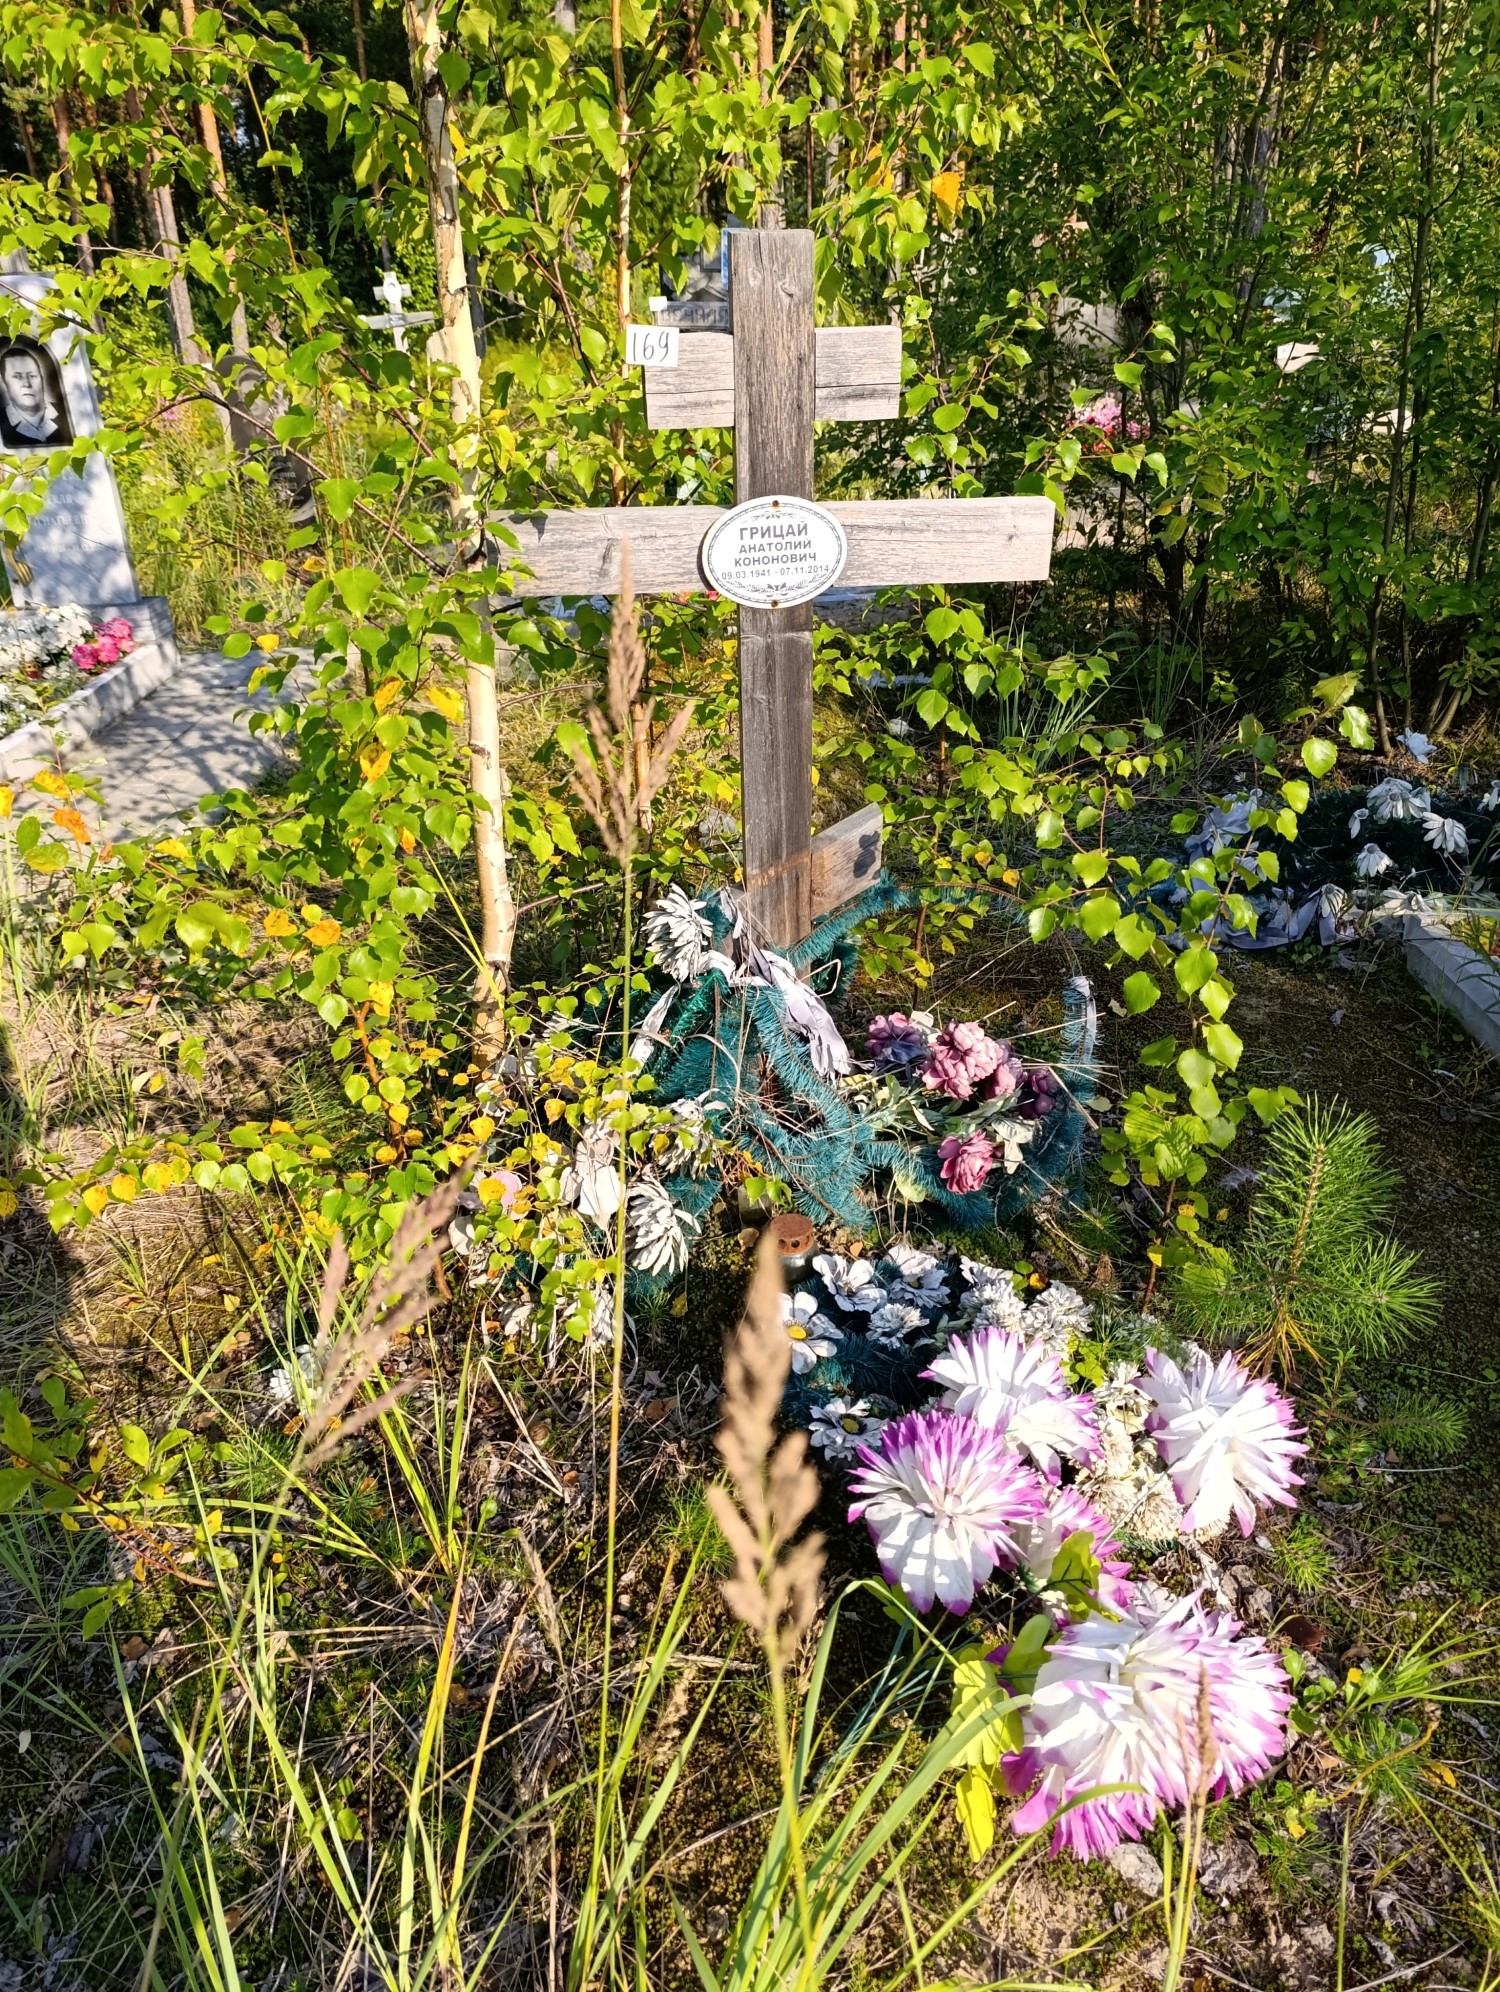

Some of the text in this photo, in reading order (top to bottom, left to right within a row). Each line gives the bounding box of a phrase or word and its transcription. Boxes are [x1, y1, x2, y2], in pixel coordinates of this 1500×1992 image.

[632, 330, 670, 363] 169
[739, 520, 808, 540] ГРИЦАЙ
[738, 538, 812, 555] АНАТОЛИЙ
[734, 552, 816, 568] КОНОНОВИЧ
[721, 568, 771, 580] 09.03.1941
[780, 564, 829, 576] 07.11.2014
